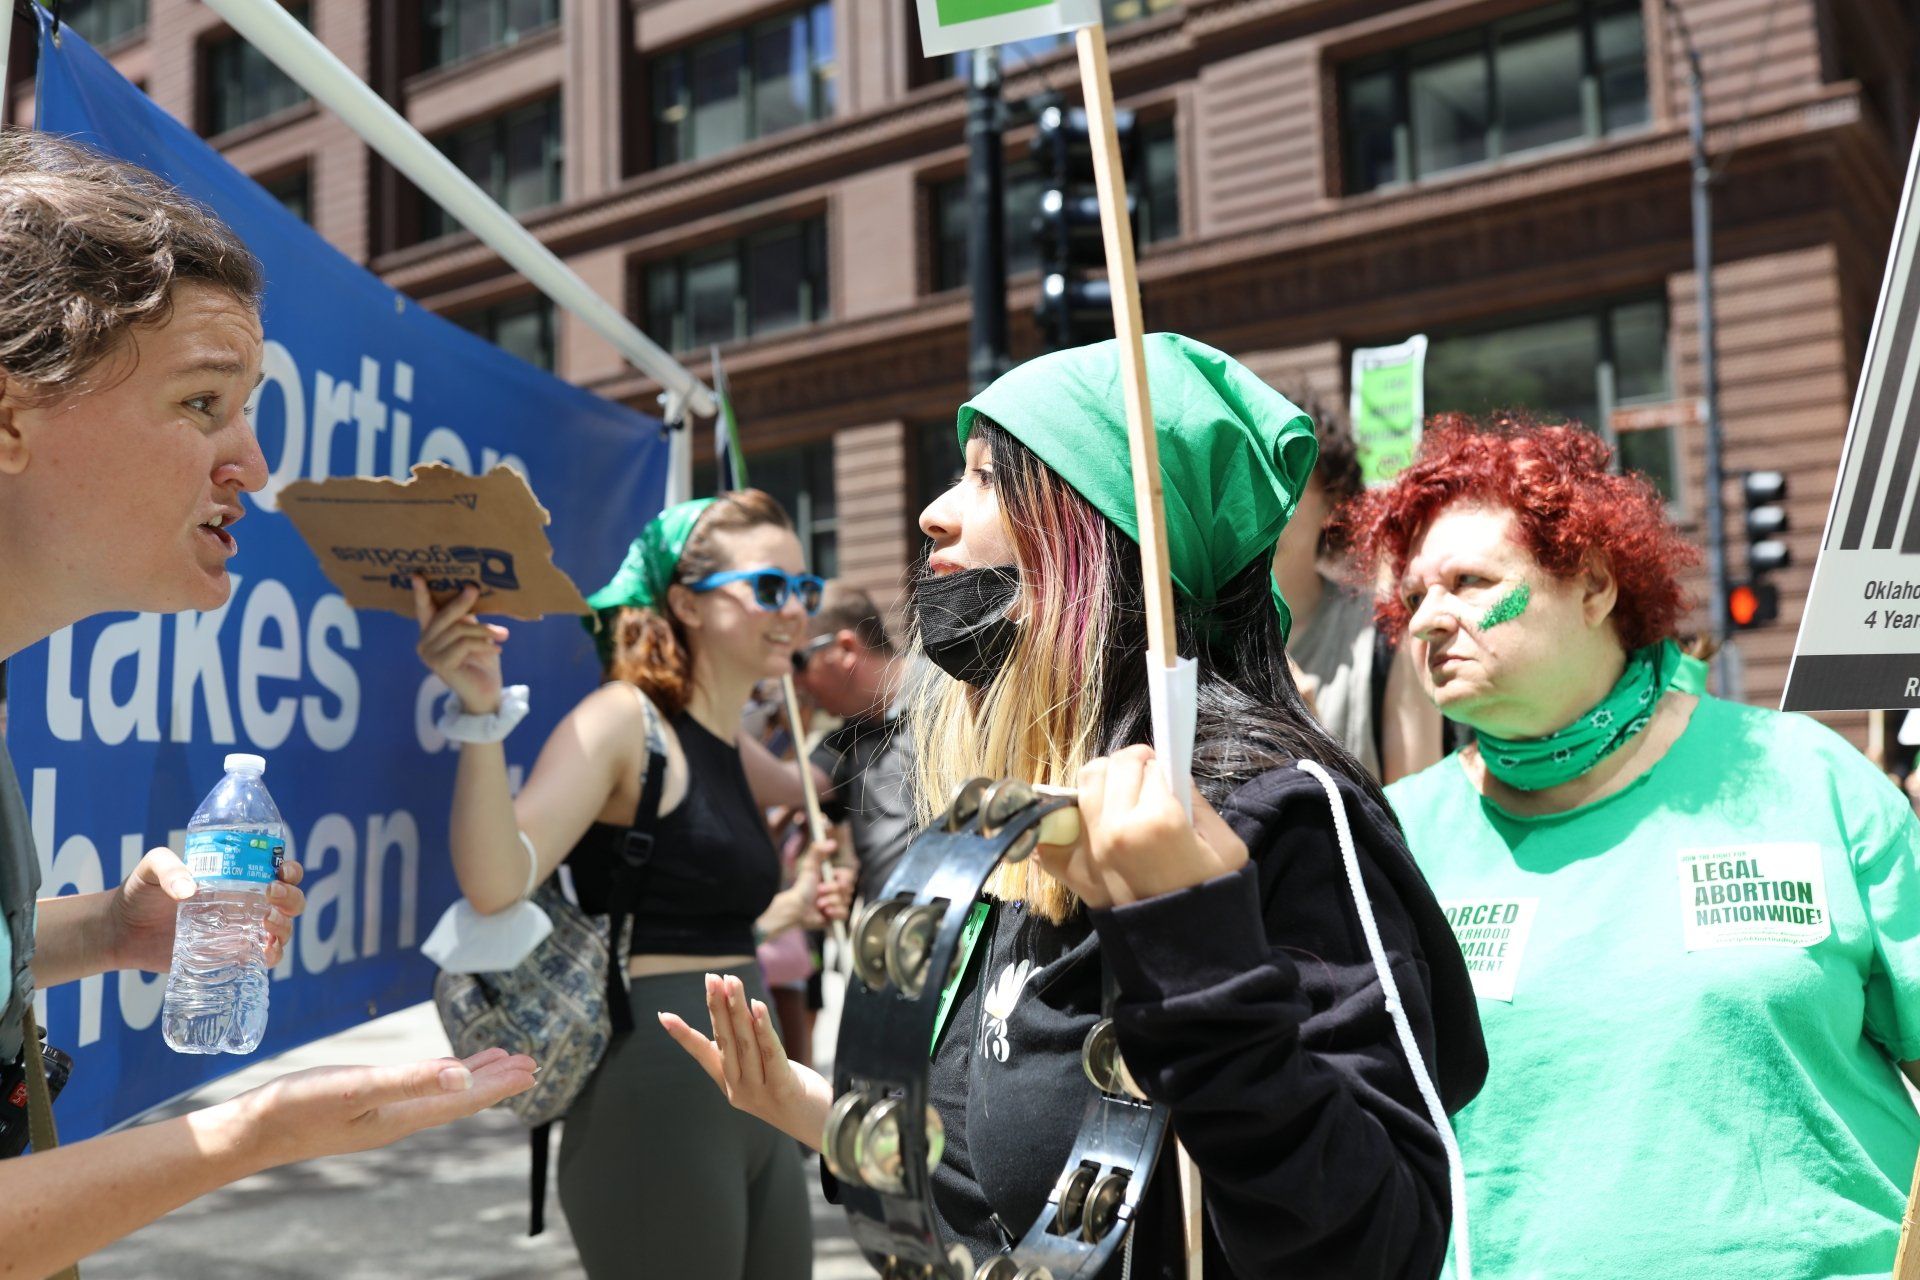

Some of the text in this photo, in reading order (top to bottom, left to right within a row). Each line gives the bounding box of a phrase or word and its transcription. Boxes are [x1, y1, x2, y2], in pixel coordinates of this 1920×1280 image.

[1863, 580, 1920, 600] Oklaho
[1864, 610, 1877, 628] 4
[222, 866, 244, 876] CA CRV
[1691, 859, 1764, 882] LEGAL
[1695, 881, 1813, 906] ABORTION
[1696, 905, 1823, 926] NATIONWIDE!
[1454, 928, 1510, 940] ERHOOD
